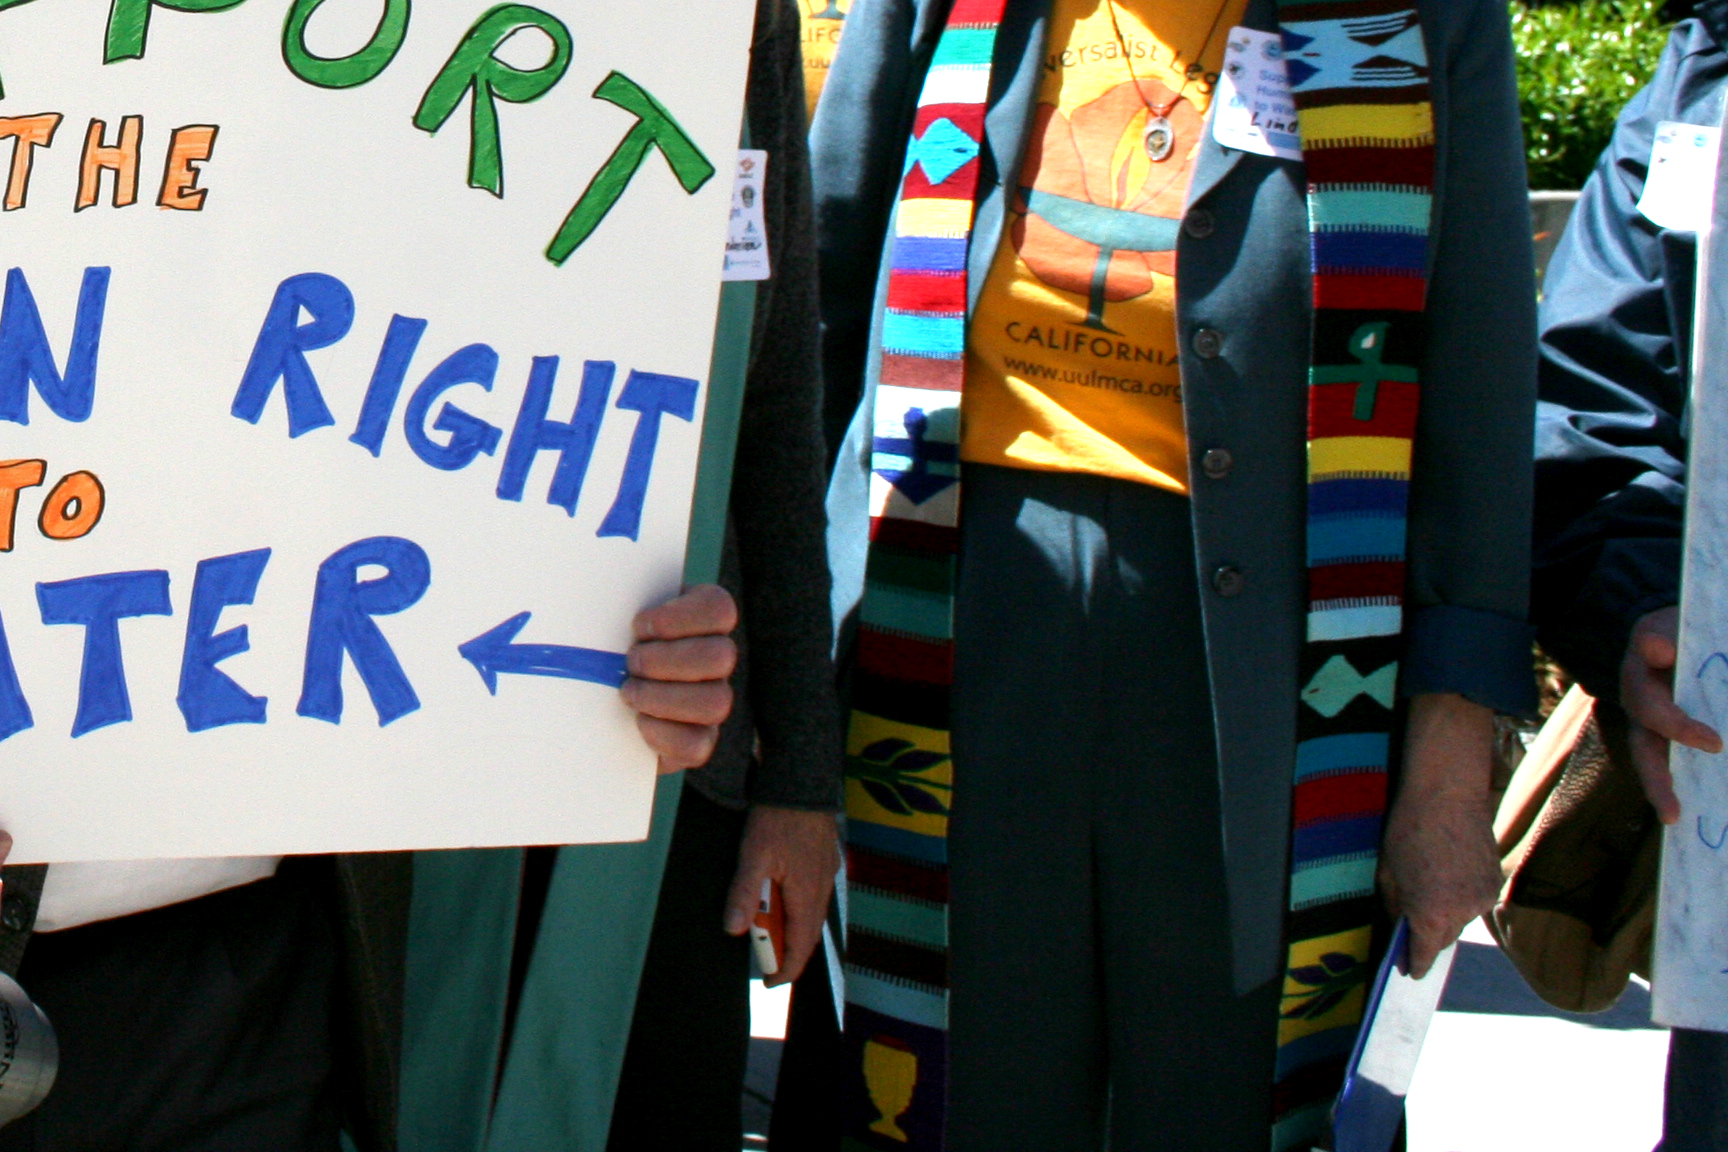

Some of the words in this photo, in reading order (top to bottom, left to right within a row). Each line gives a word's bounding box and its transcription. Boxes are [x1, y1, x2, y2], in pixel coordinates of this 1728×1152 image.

[1044, 33, 1159, 72] versalist
[1250, 111, 1298, 134] Lind
[231, 272, 699, 541] RIGHT
